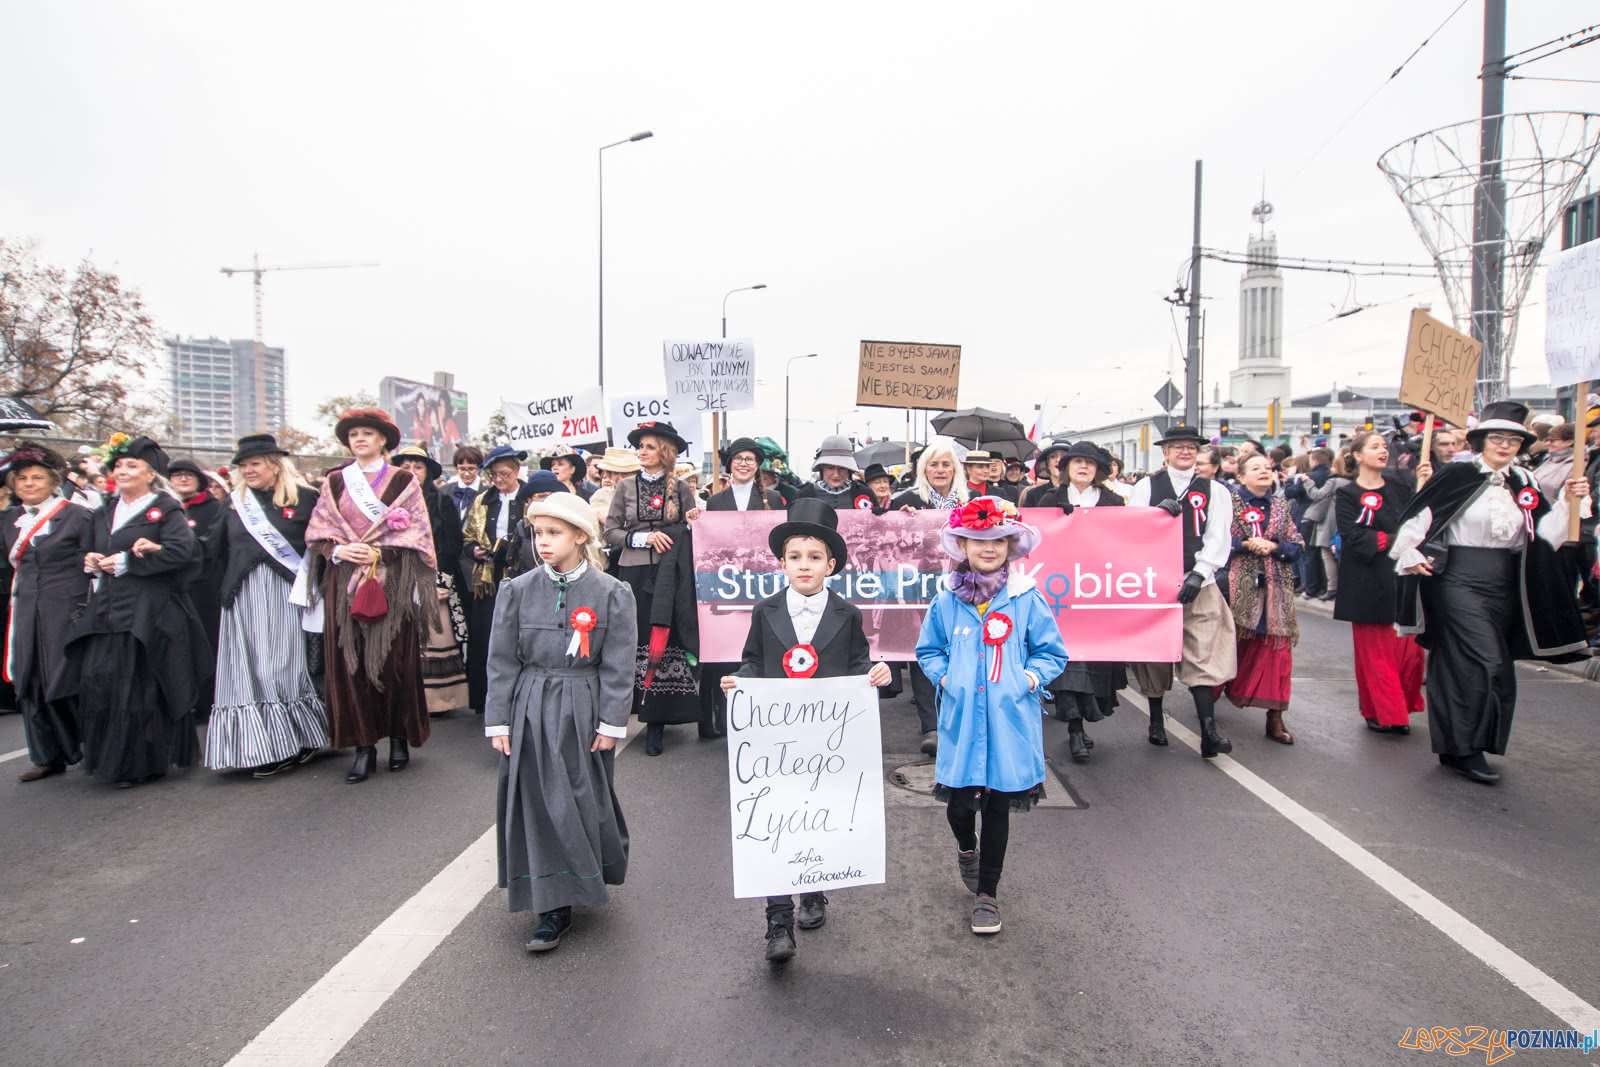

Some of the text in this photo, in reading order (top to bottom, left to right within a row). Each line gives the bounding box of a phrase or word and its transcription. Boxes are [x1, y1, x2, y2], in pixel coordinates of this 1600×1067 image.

[863, 343, 884, 359] NIE
[1419, 323, 1481, 379] CHCEMY
[710, 360, 750, 377] WOLNYMI
[862, 376, 883, 396] NIE
[527, 395, 574, 416] CHCEMY
[510, 416, 599, 440] CAŁEGO ŻYCIA
[731, 689, 866, 751] Chcemy
[736, 740, 845, 791] Całego
[787, 847, 825, 864] Zofia
